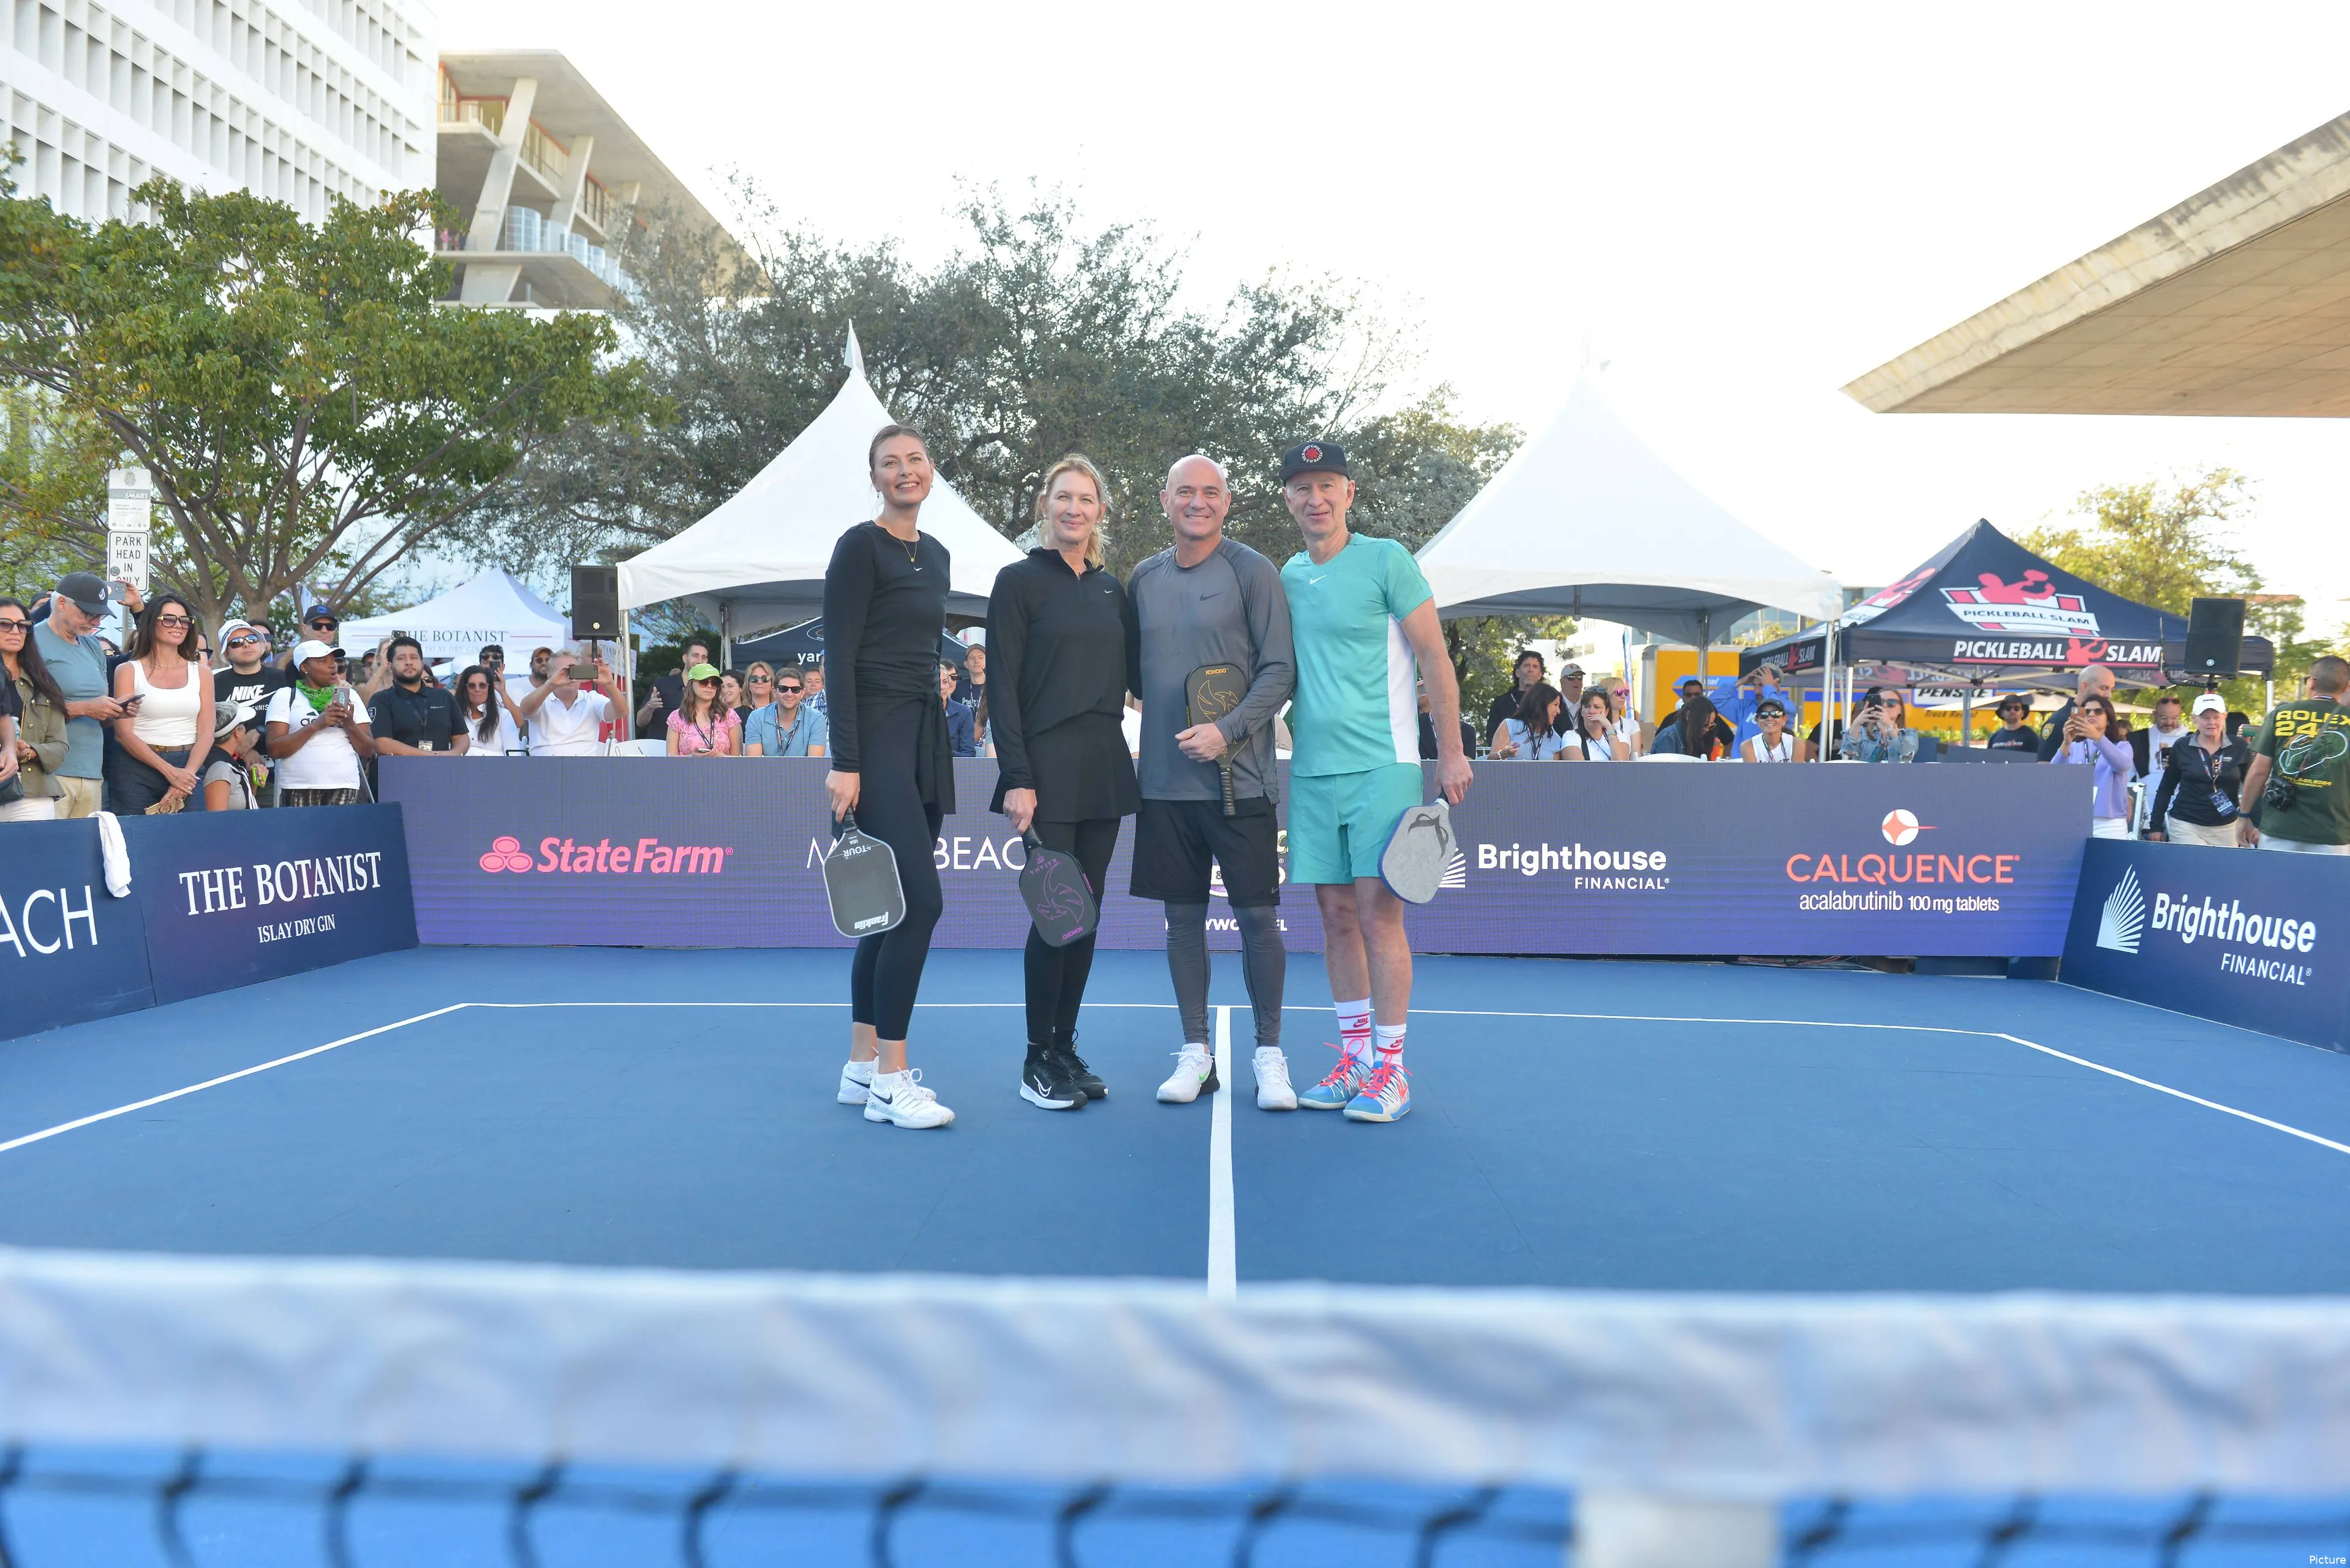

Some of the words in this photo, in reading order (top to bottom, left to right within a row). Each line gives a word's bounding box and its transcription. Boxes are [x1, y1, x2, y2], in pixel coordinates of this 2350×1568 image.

[116, 537, 141, 546] PARK
[116, 549, 141, 559] HEAD
[124, 563, 133, 572] IN
[1964, 610, 2047, 620] PICKLEBALL
[2051, 614, 2089, 625] SLAM
[408, 630, 427, 642] HE
[433, 630, 507, 642] BOTANIST
[797, 652, 821, 665] yar
[1798, 645, 1816, 663] SLAM
[1954, 640, 2066, 660] PICKLEBALL
[2106, 645, 2162, 663] SLAM
[231, 684, 265, 701] NIKE
[1949, 710, 1978, 718] Renal
[2275, 709, 2350, 726] ROLEX
[2275, 720, 2318, 738] 24
[843, 845, 868, 857] TOUR
[933, 836, 1026, 870] BEAC
[1478, 843, 1667, 876] Brighthouse
[179, 867, 246, 916] THE
[253, 851, 381, 906] BOTANIST
[1799, 890, 1904, 911] acalabrutinib
[1907, 895, 1931, 911] 100
[1932, 899, 1953, 914] mg
[1956, 895, 2000, 911] tablets
[257, 921, 292, 943] ISLAY
[294, 918, 315, 937] DRY
[317, 914, 336, 932] GIN
[2152, 892, 2316, 953] Brighthouse
